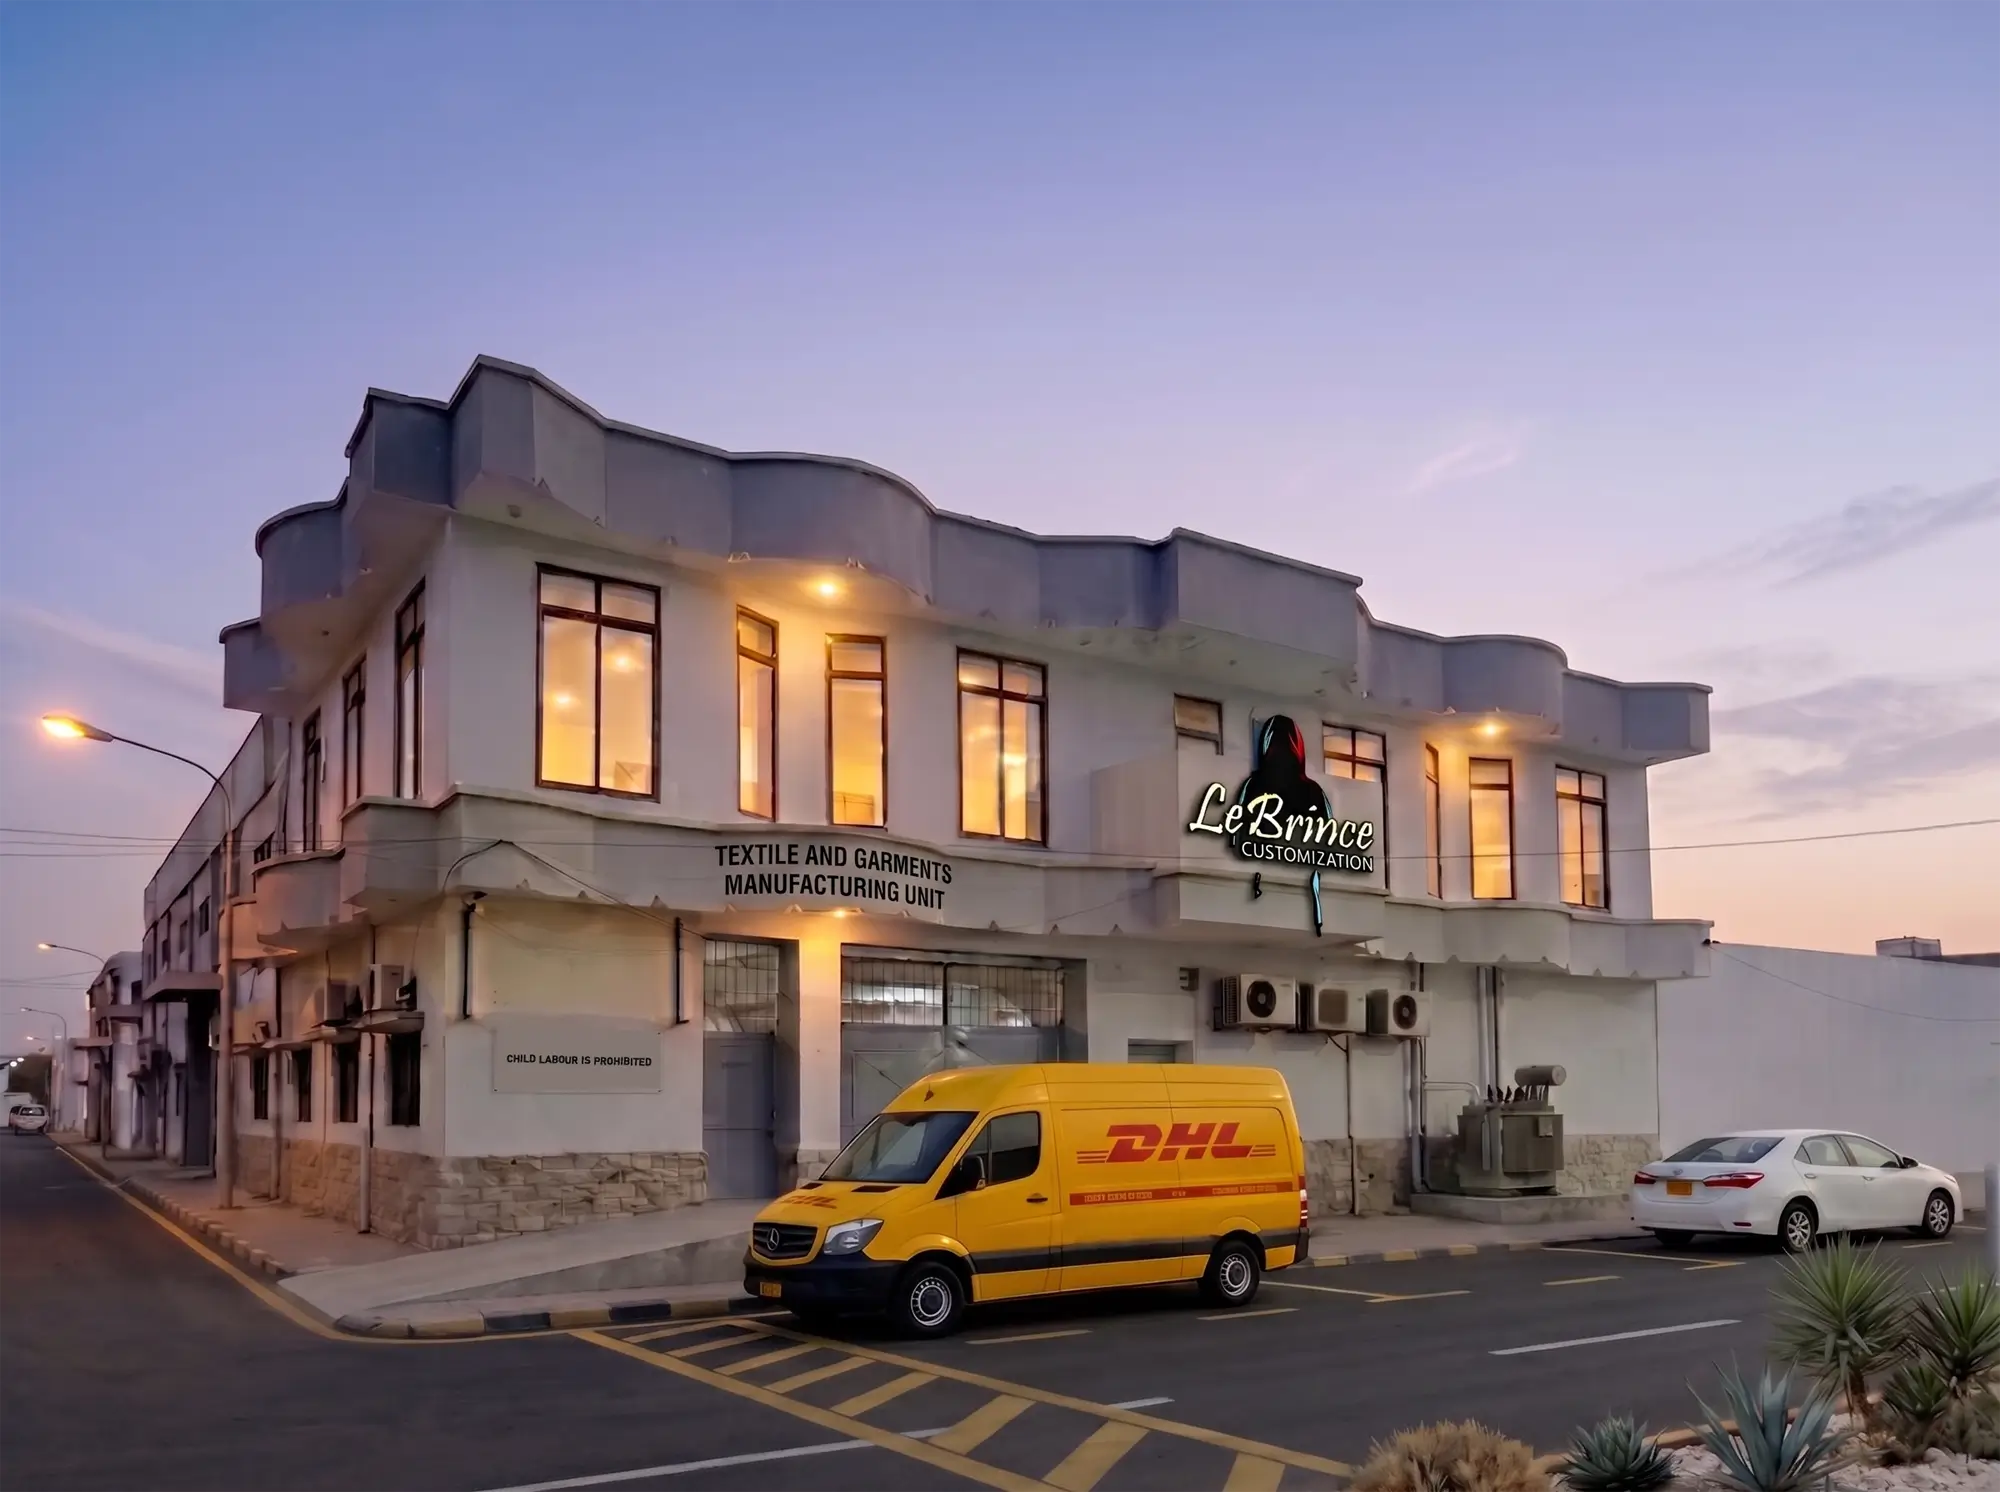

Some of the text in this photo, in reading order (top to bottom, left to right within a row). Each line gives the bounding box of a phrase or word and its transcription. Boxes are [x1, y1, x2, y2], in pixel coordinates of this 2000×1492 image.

[715, 844, 952, 884] TEXTILE AND GARMENTS
[1241, 841, 1374, 872] CUSTOMIZATION
[725, 874, 945, 910] MANUFACTURING UNIT
[506, 1054, 652, 1067] CHILD LABOUR IS PROHIBITED
[1105, 1122, 1254, 1163] DHL
